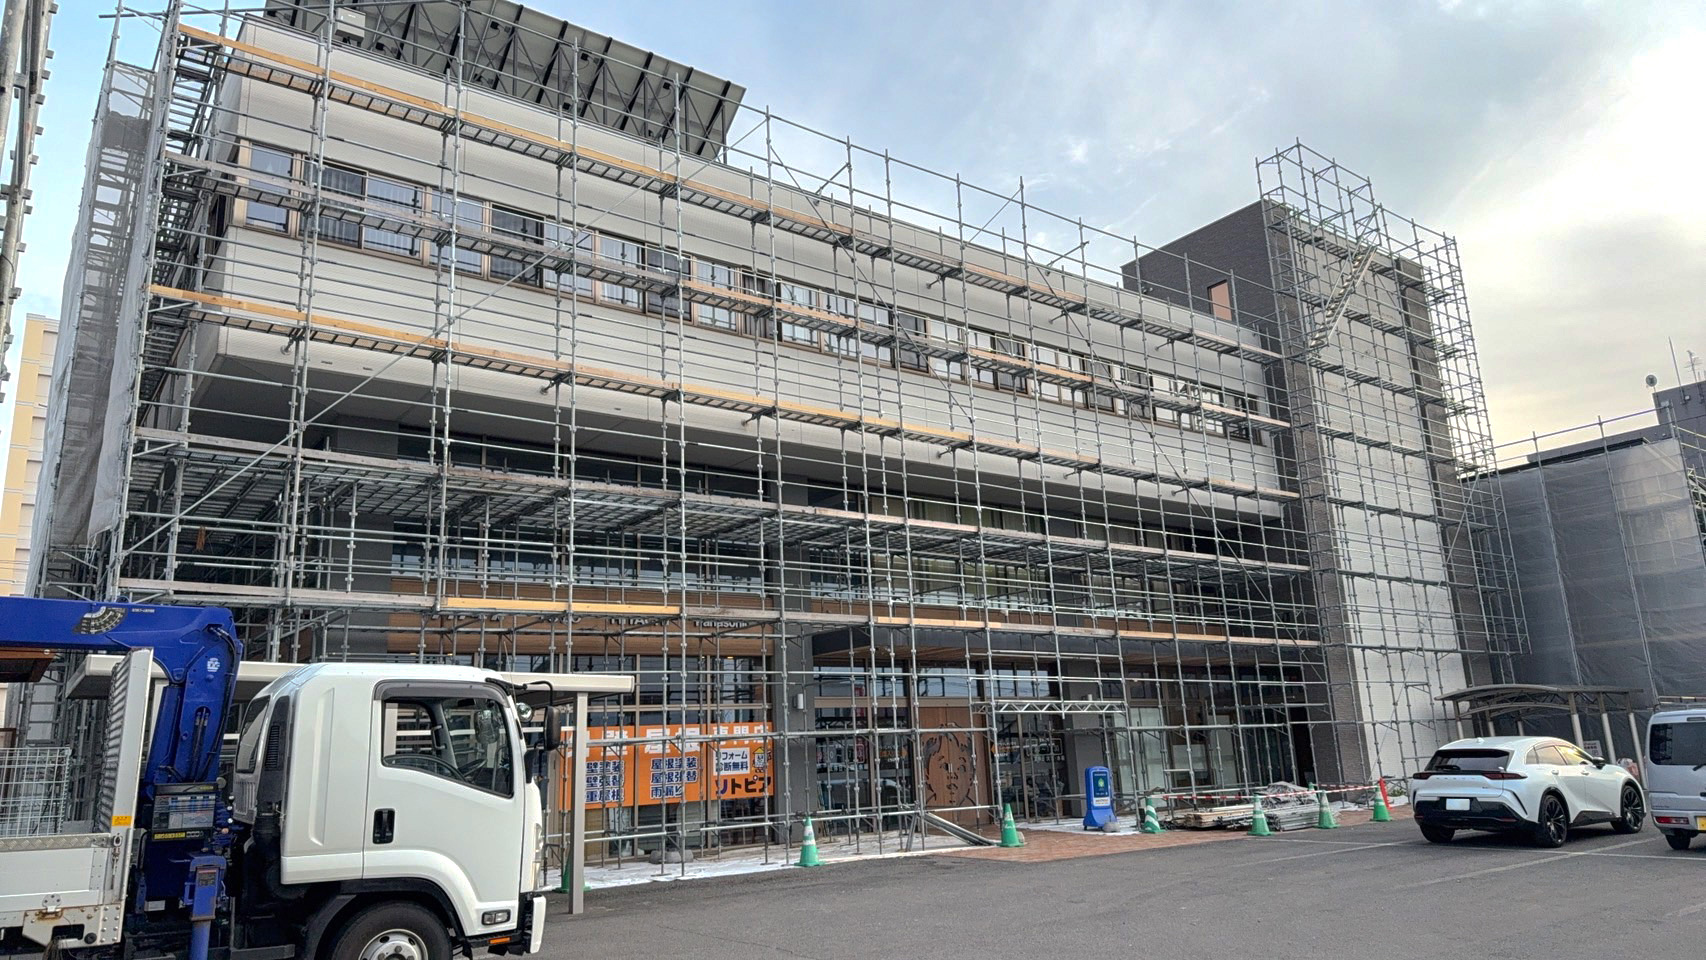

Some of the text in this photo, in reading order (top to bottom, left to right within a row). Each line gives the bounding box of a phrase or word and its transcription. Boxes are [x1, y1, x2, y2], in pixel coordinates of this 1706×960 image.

[713, 725, 769, 745] 専門店
[585, 760, 624, 774] 壁塗装
[650, 756, 698, 771] 屋根塗装
[585, 774, 624, 789] 壁張替
[585, 788, 624, 803] 重屋根
